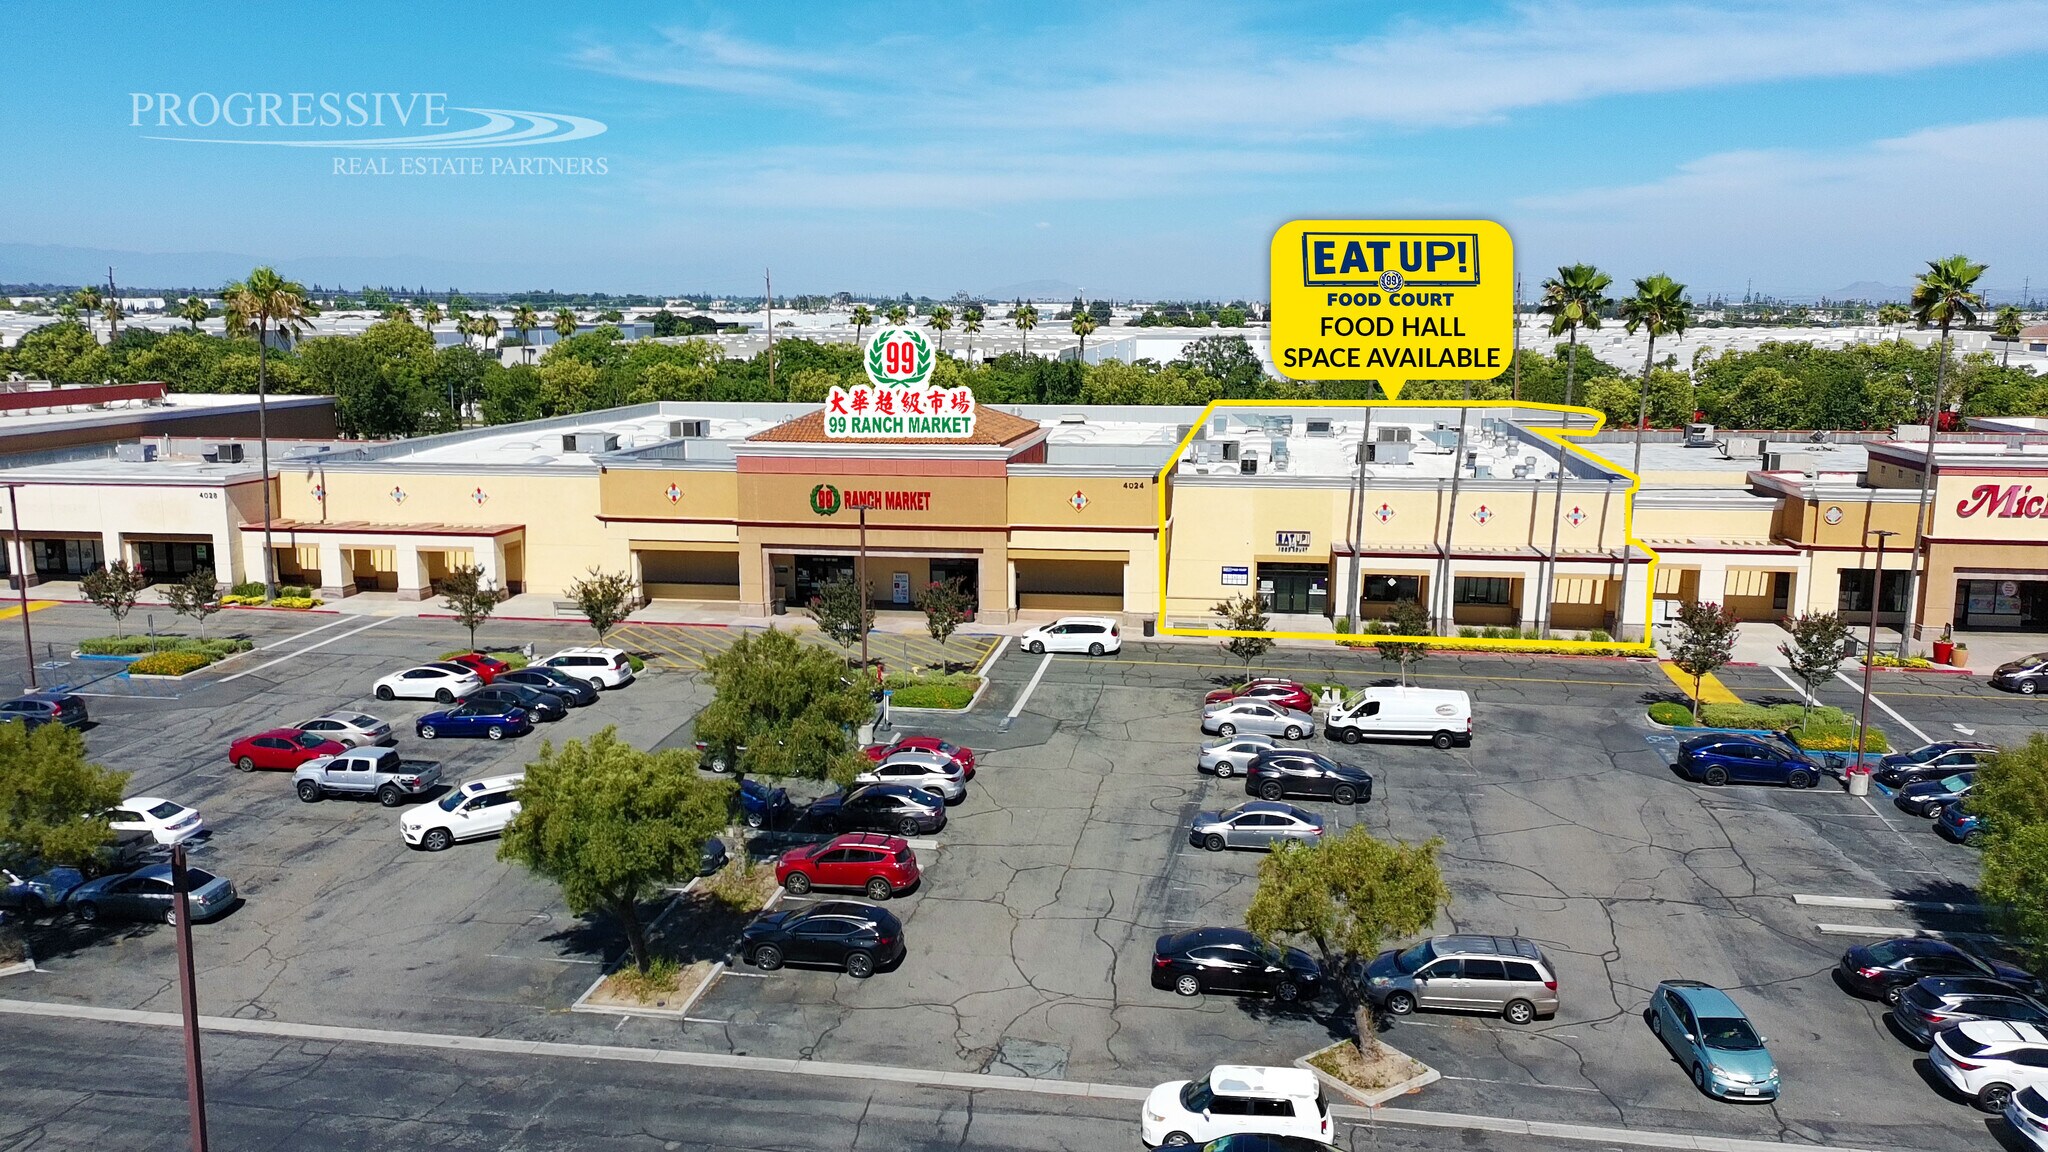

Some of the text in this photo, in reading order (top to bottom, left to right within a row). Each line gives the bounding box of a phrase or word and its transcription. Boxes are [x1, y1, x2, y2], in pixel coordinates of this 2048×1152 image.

[1123, 482, 1144, 490] 4024
[843, 490, 882, 510] RANCH
[885, 491, 931, 511] MARKET
